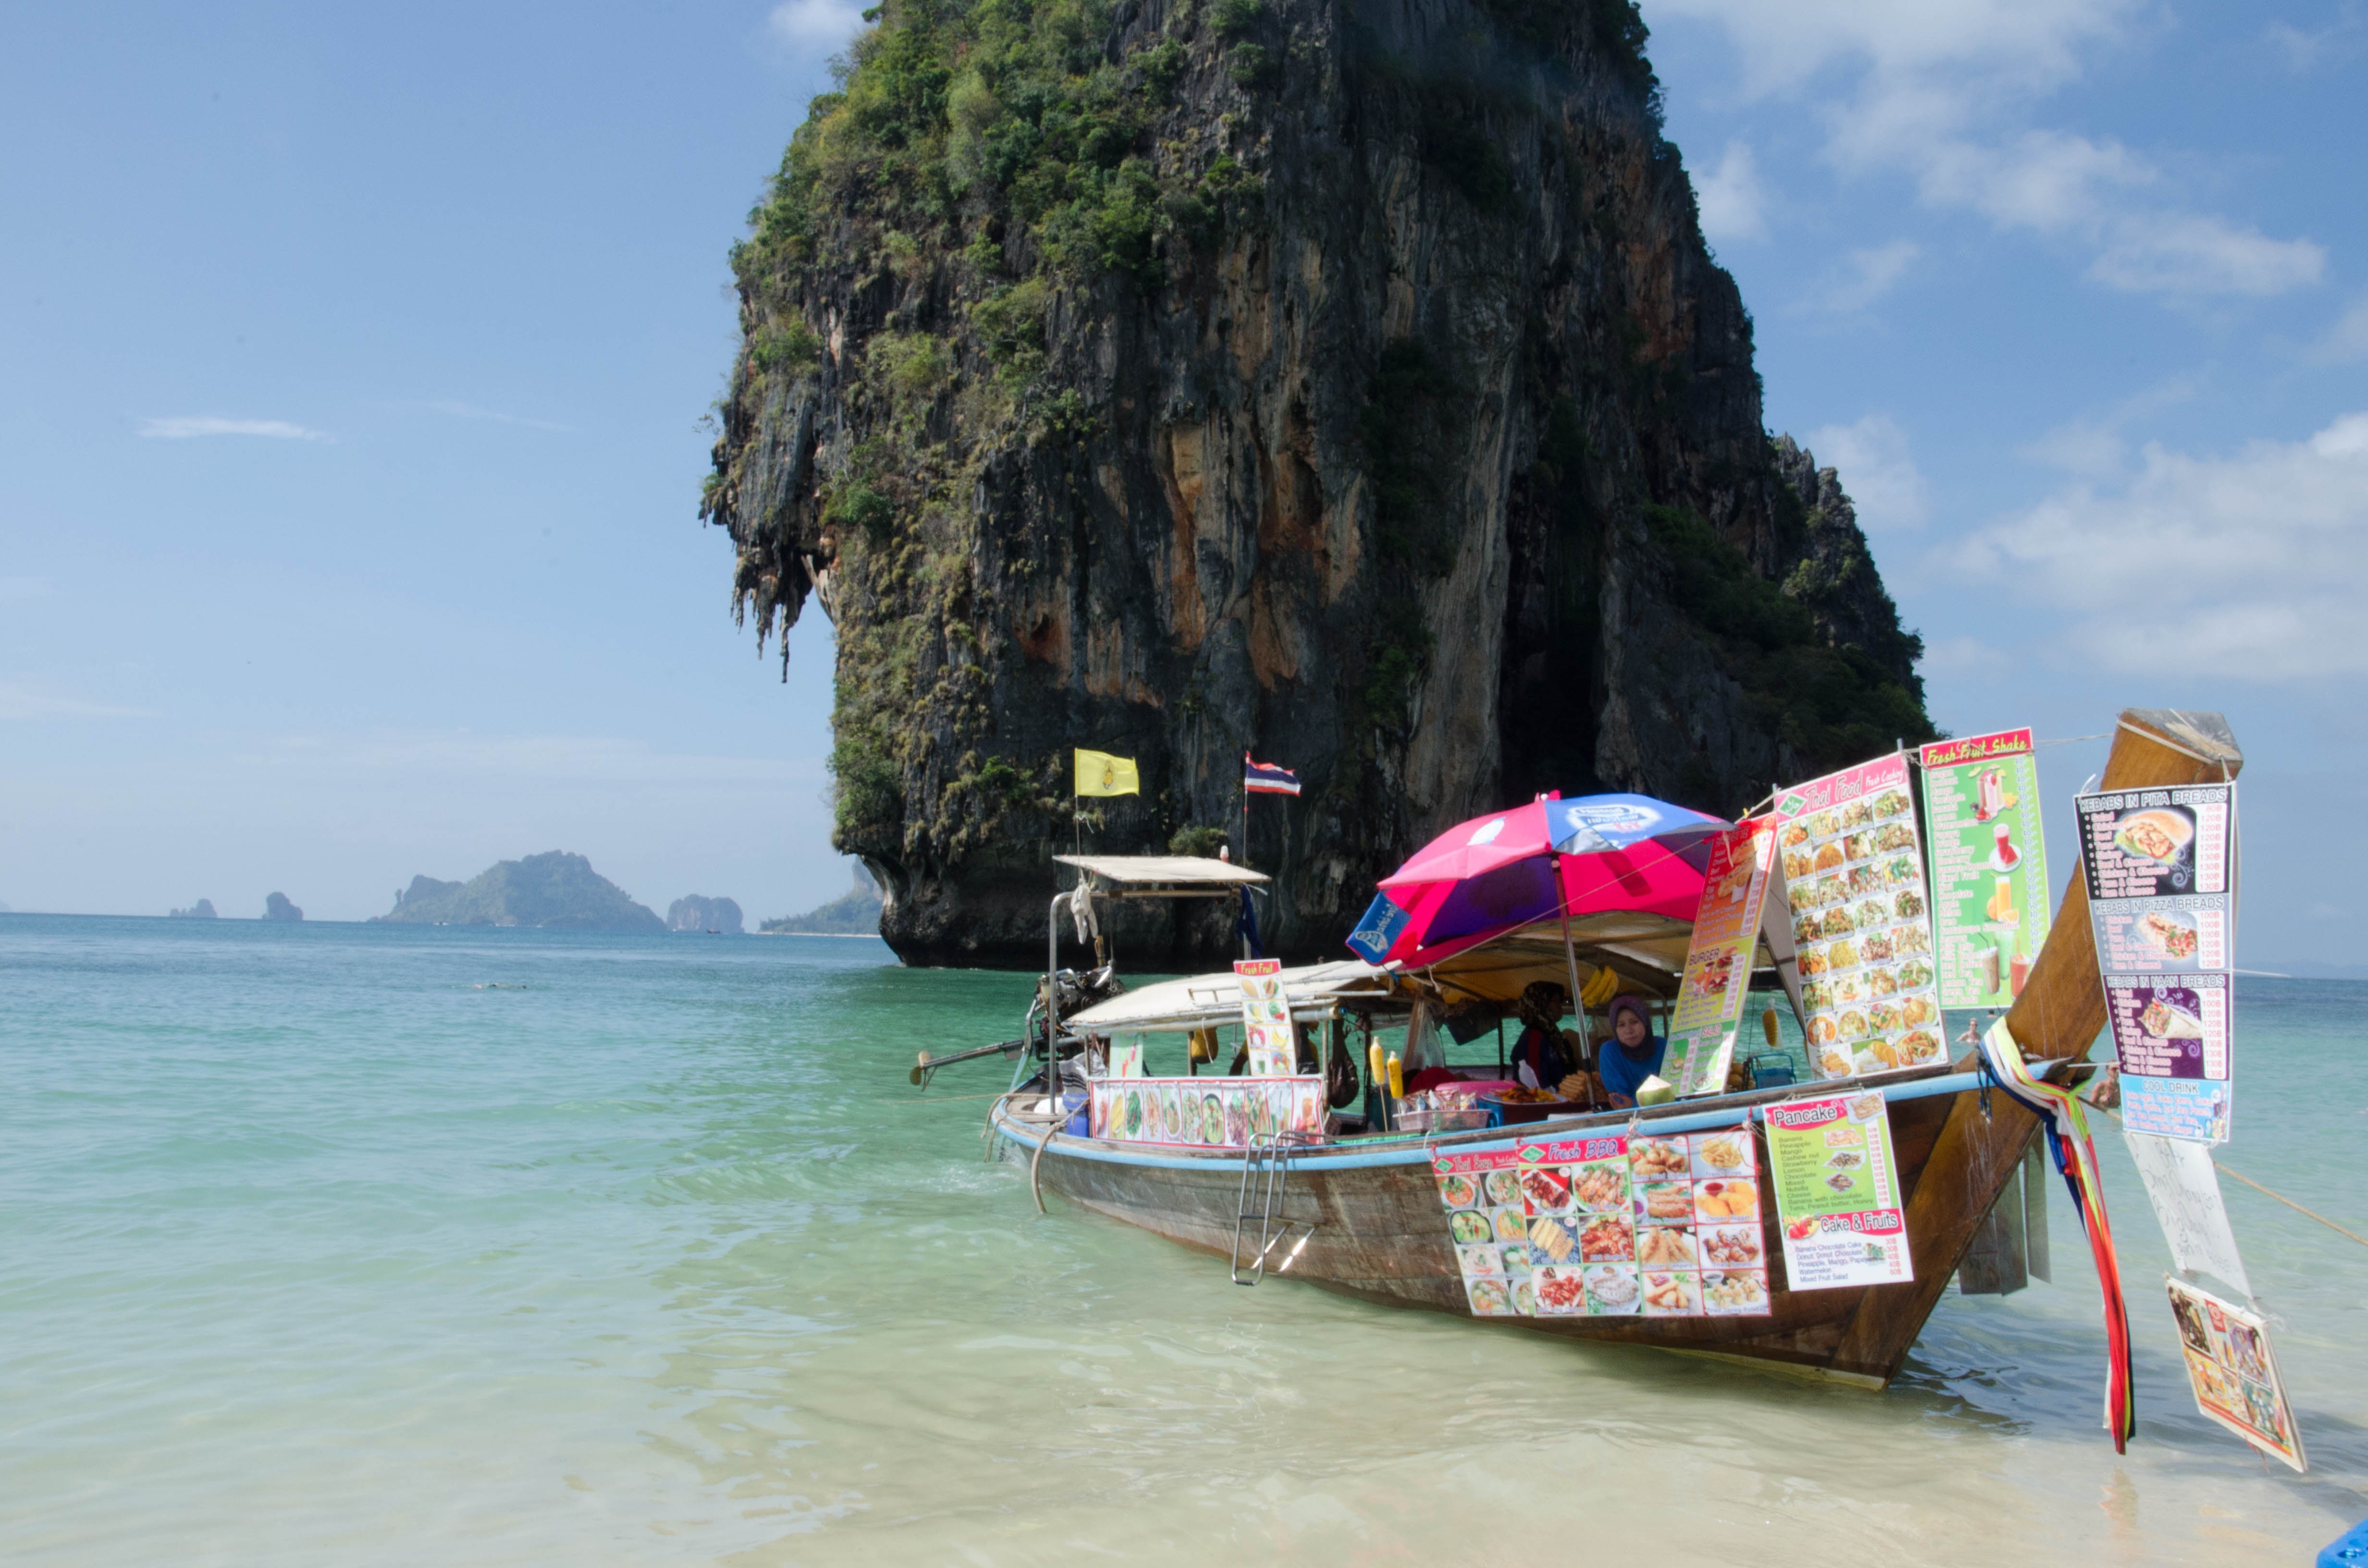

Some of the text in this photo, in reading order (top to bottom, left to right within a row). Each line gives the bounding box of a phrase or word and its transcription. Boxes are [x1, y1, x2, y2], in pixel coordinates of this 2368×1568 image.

[1927, 735, 2026, 764] Fresh Fruit Shake
[1866, 768, 1903, 787] Fresh Cooking
[1806, 770, 1862, 811] Thai Food
[2080, 788, 2227, 813] KEBABS IN PITA BREADS
[2092, 822, 2125, 832] Chicken
[2116, 859, 2122, 868] &
[2123, 858, 2154, 868] Cheese
[2098, 867, 2169, 879] Chicken & Cheese
[2119, 878, 2125, 887] &
[2126, 877, 2157, 886] Cheese
[2118, 887, 2125, 896] &
[2125, 887, 2156, 896] Cheese
[2095, 897, 2224, 915] KEBABS IN PIZZA BREADS
[2105, 916, 2133, 924] Chicken
[1689, 948, 1719, 966] BURGER
[2145, 950, 2174, 959] Cheese
[1241, 962, 1272, 976] Fresh Fruit
[2135, 961, 2161, 969] Cheese
[2139, 976, 2150, 988] IN
[2150, 975, 2179, 988] NAAN
[2180, 975, 2225, 987] BREADS
[1702, 1024, 1722, 1038] SALAD
[2143, 1081, 2199, 1093] COOL DRINK
[1775, 1105, 1836, 1127] Pancake
[1548, 1140, 1619, 1161] Fresh BBQ
[1780, 1141, 1811, 1150] Pineapple
[1453, 1155, 1492, 1172] Thai Soup
[1821, 1213, 1897, 1232] Cake & Fruits
